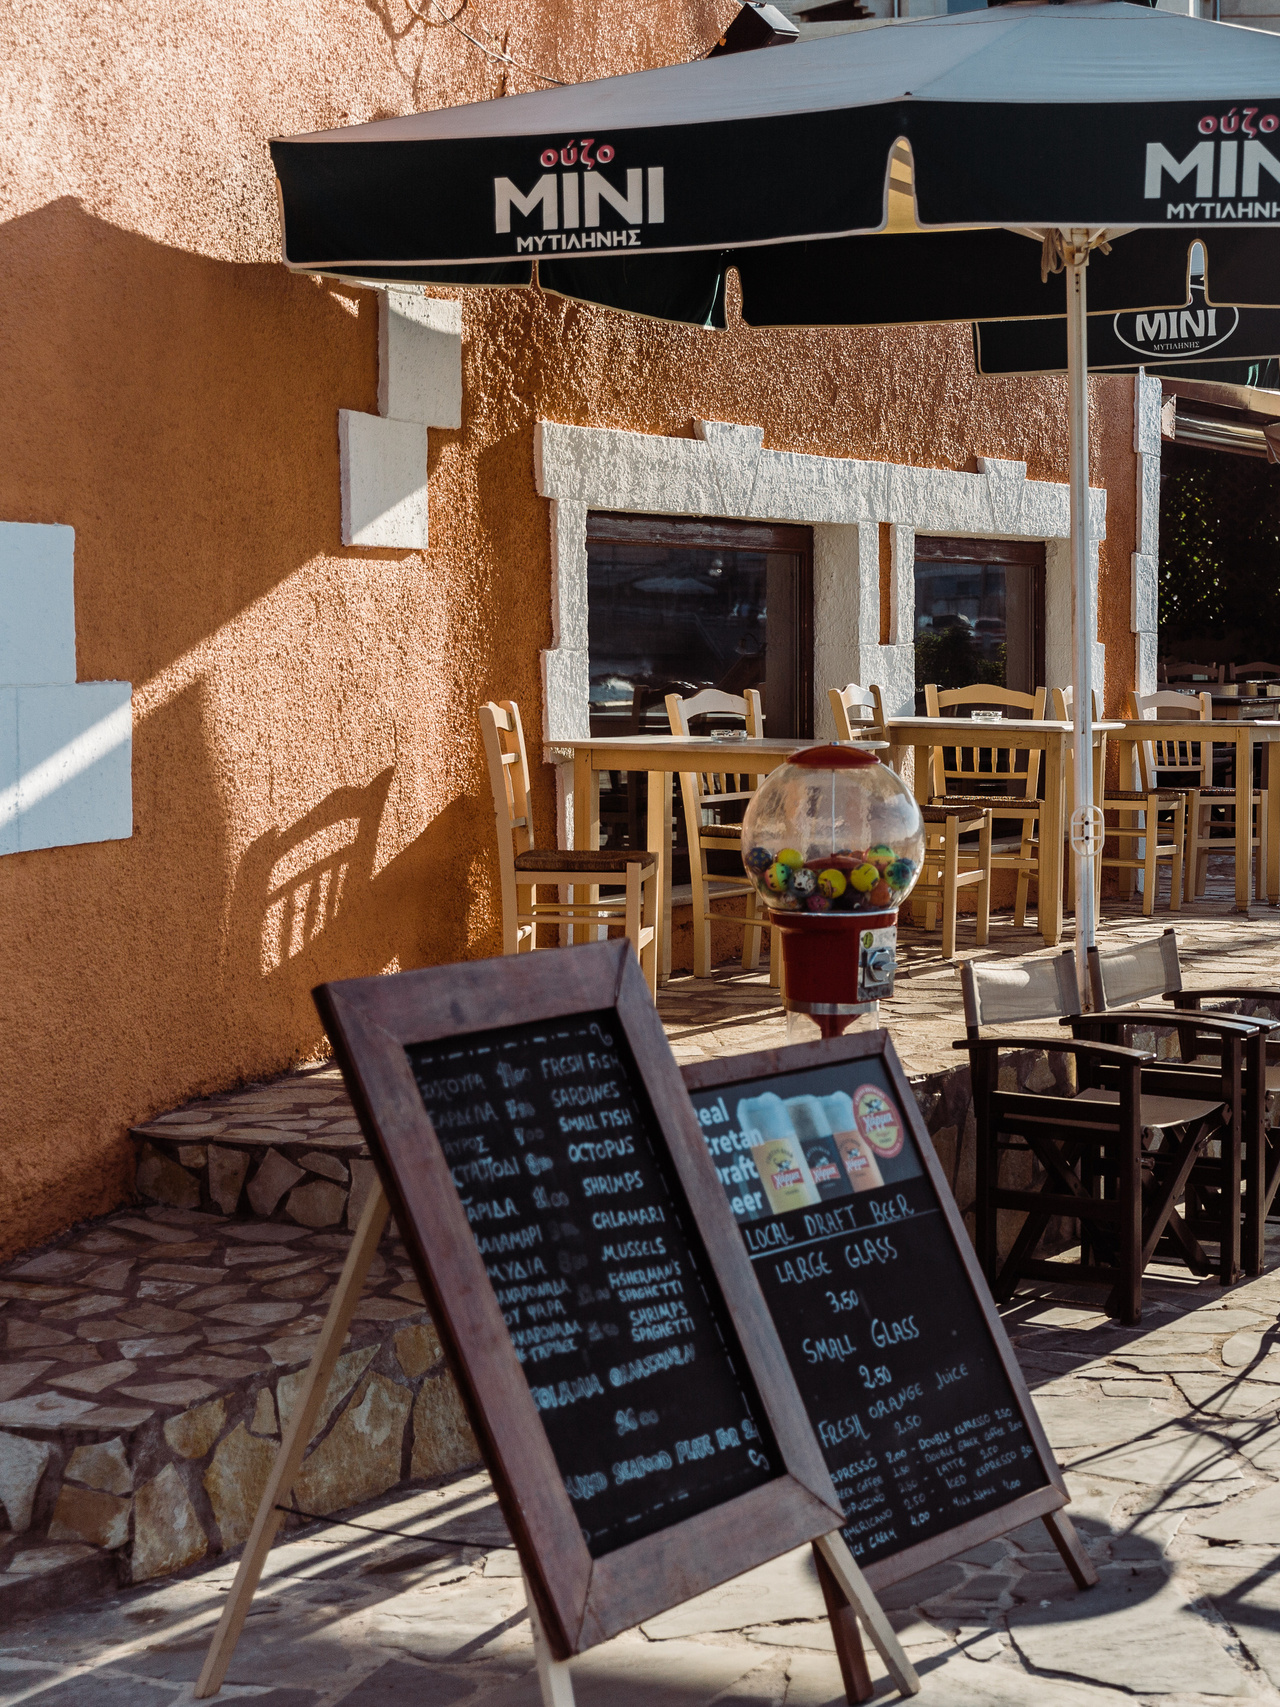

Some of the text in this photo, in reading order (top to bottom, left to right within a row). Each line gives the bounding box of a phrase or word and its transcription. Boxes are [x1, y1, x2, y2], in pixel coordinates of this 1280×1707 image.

[1197, 107, 1280, 139] ούζο
[540, 138, 615, 170] ούζο
[494, 166, 665, 234] MINI
[516, 229, 641, 253] ΜΥΤΙΛΗΝΗΣ
[1135, 308, 1217, 342] MINI
[540, 1054, 585, 1079] FRESH
[551, 1081, 620, 1108] SARDINES
[558, 1108, 633, 1133] SMALL FISH
[568, 1136, 635, 1163] OCTOPUS
[582, 1170, 644, 1197] SHRIMPS
[730, 1191, 763, 1216] eer
[592, 1205, 666, 1230] CALAMARI
[745, 1194, 915, 1251] LOCAL DRAFT BEER
[601, 1236, 667, 1262] MUSSELS
[775, 1236, 898, 1284] LARGE GLASS
[618, 1280, 684, 1303] SPAGHETTI
[629, 1301, 688, 1327] SHRIMPS
[631, 1317, 696, 1343] SPAGHETTI
[802, 1315, 920, 1364] SMALL GLASS
[818, 1414, 871, 1448] FRESH
[868, 1382, 924, 1420] ORANGE
[830, 1456, 878, 1484] SPRESSO
[918, 1430, 951, 1451] DOUBLE
[954, 1413, 991, 1436] ESPRESSO
[924, 1448, 955, 1464] DOUBLE
[612, 1450, 673, 1485] SEAFOOD
[936, 1456, 967, 1477] LATTE
[842, 1508, 893, 1542] AMERICANO
[975, 1450, 1017, 1478] ESPRESSO
[869, 1528, 898, 1549] CREAM
